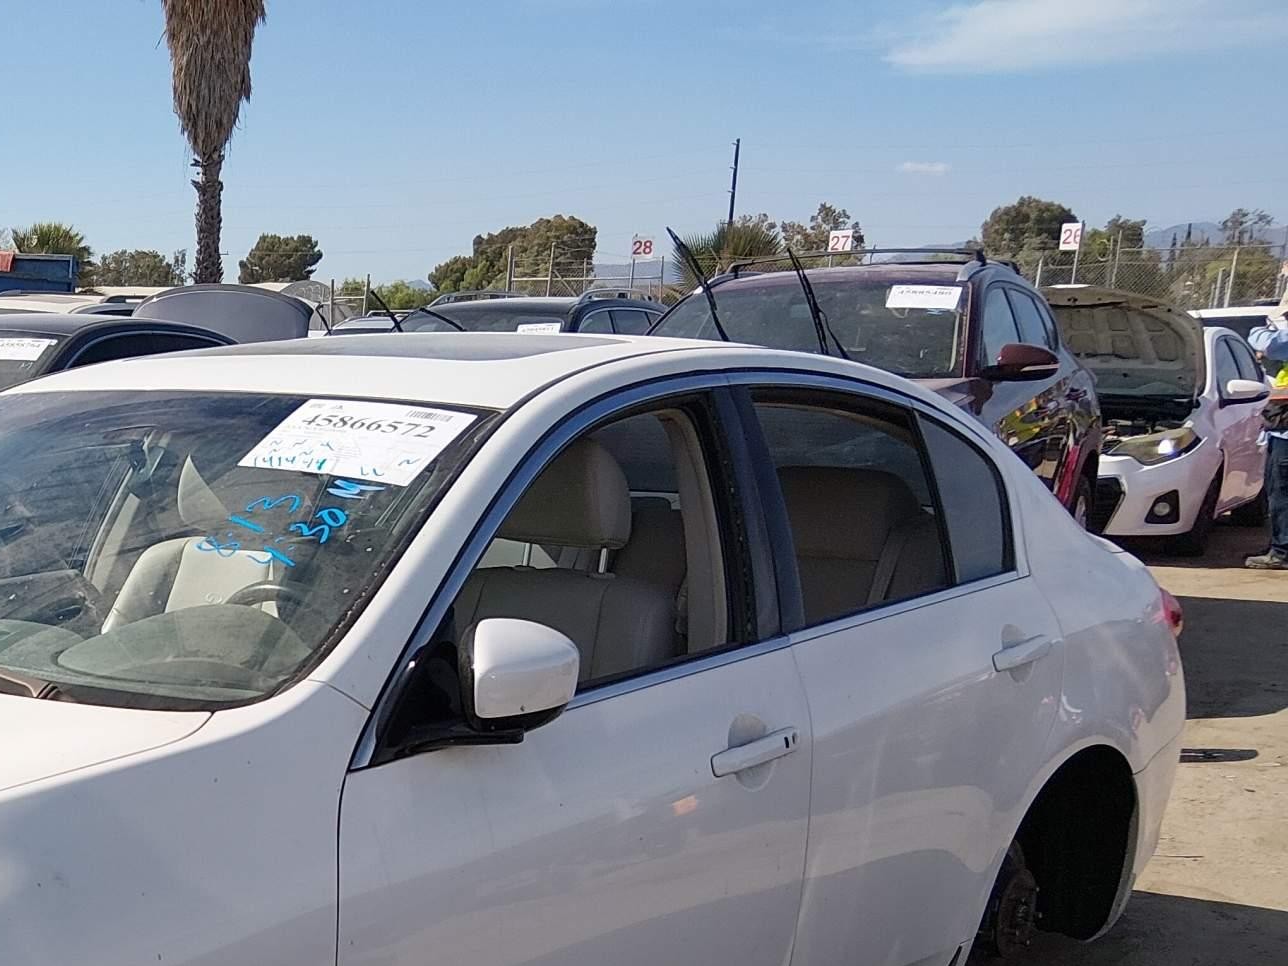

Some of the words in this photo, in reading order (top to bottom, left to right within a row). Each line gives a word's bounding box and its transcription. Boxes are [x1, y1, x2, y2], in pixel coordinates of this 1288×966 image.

[632, 239, 653, 255] 28
[830, 234, 850, 251] 27
[301, 412, 436, 439] 45866572
